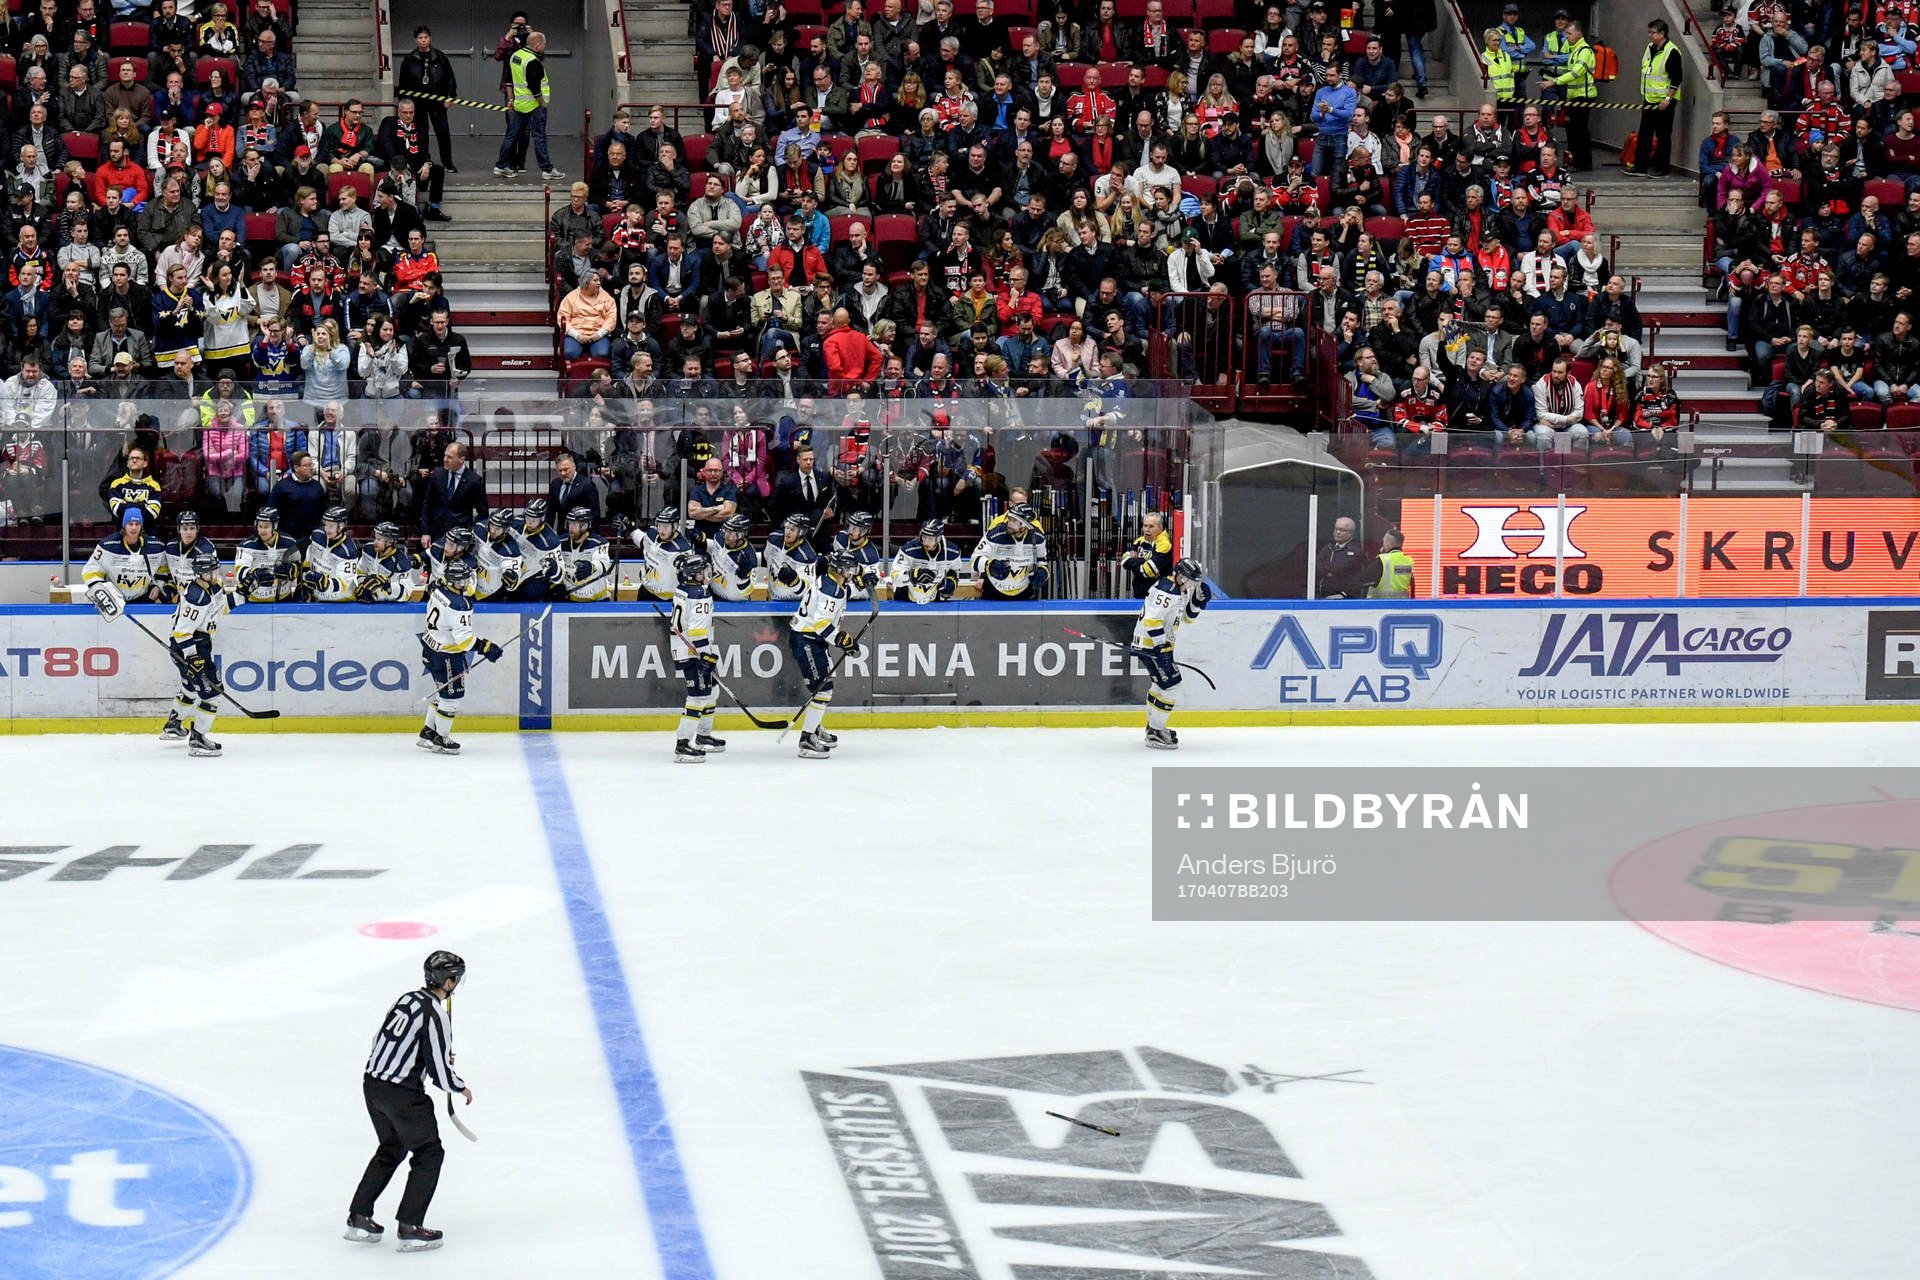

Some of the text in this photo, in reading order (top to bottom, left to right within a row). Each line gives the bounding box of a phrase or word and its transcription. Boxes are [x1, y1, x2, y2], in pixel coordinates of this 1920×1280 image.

[1442, 563, 1604, 596] HECO
[183, 606, 199, 622] 90
[695, 602, 710, 615] 20
[823, 600, 836, 613] 13
[1155, 594, 1172, 608] 55
[1518, 613, 1793, 677] JATA CARGO
[214, 650, 411, 692] ordea
[526, 616, 544, 706] CCM
[1279, 674, 1411, 703] EL AB
[1517, 687, 1791, 700] YOUR LOGISTIC PARTNER WORLDWIDE
[385, 1008, 410, 1037] 70
[820, 1090, 964, 1269] SLUTSPEL 2017
